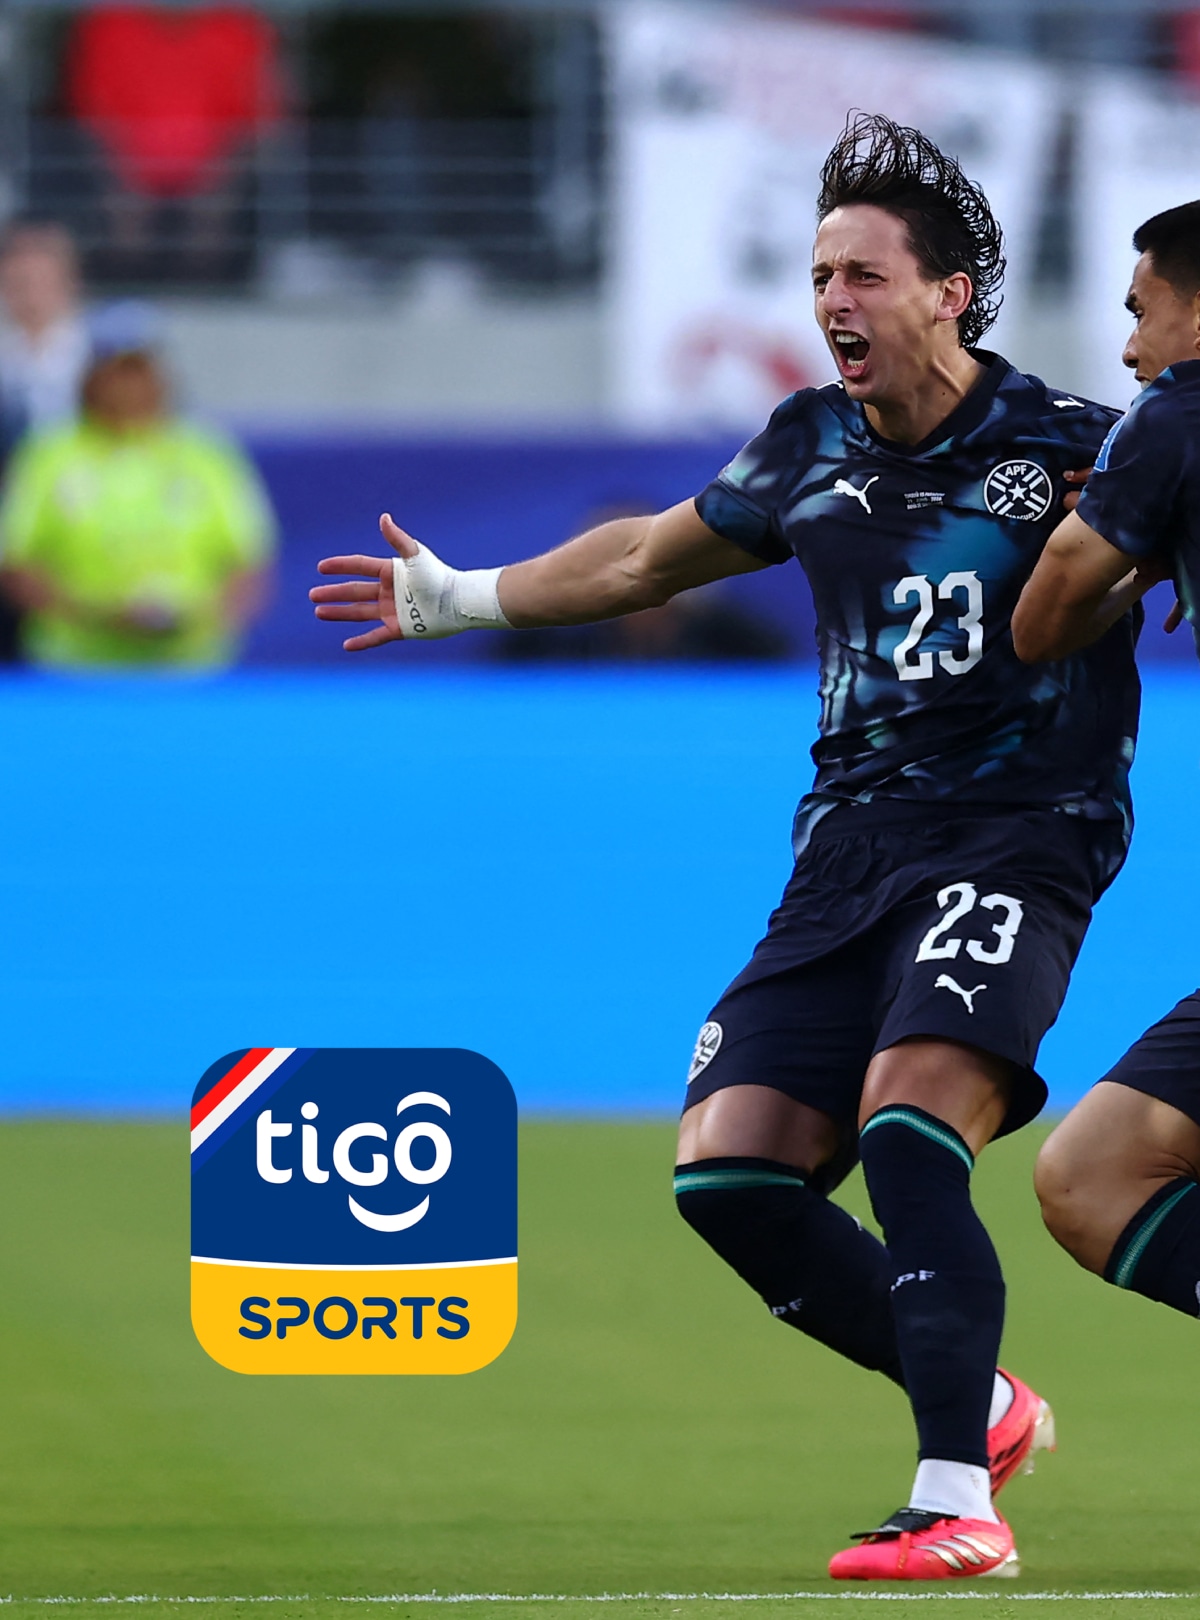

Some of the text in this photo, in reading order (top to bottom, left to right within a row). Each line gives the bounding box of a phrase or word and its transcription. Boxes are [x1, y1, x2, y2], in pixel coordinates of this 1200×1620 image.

[1005, 464, 1027, 477] APF
[892, 570, 985, 682] 23
[915, 881, 1024, 965] 23
[890, 1269, 936, 1292] PF
